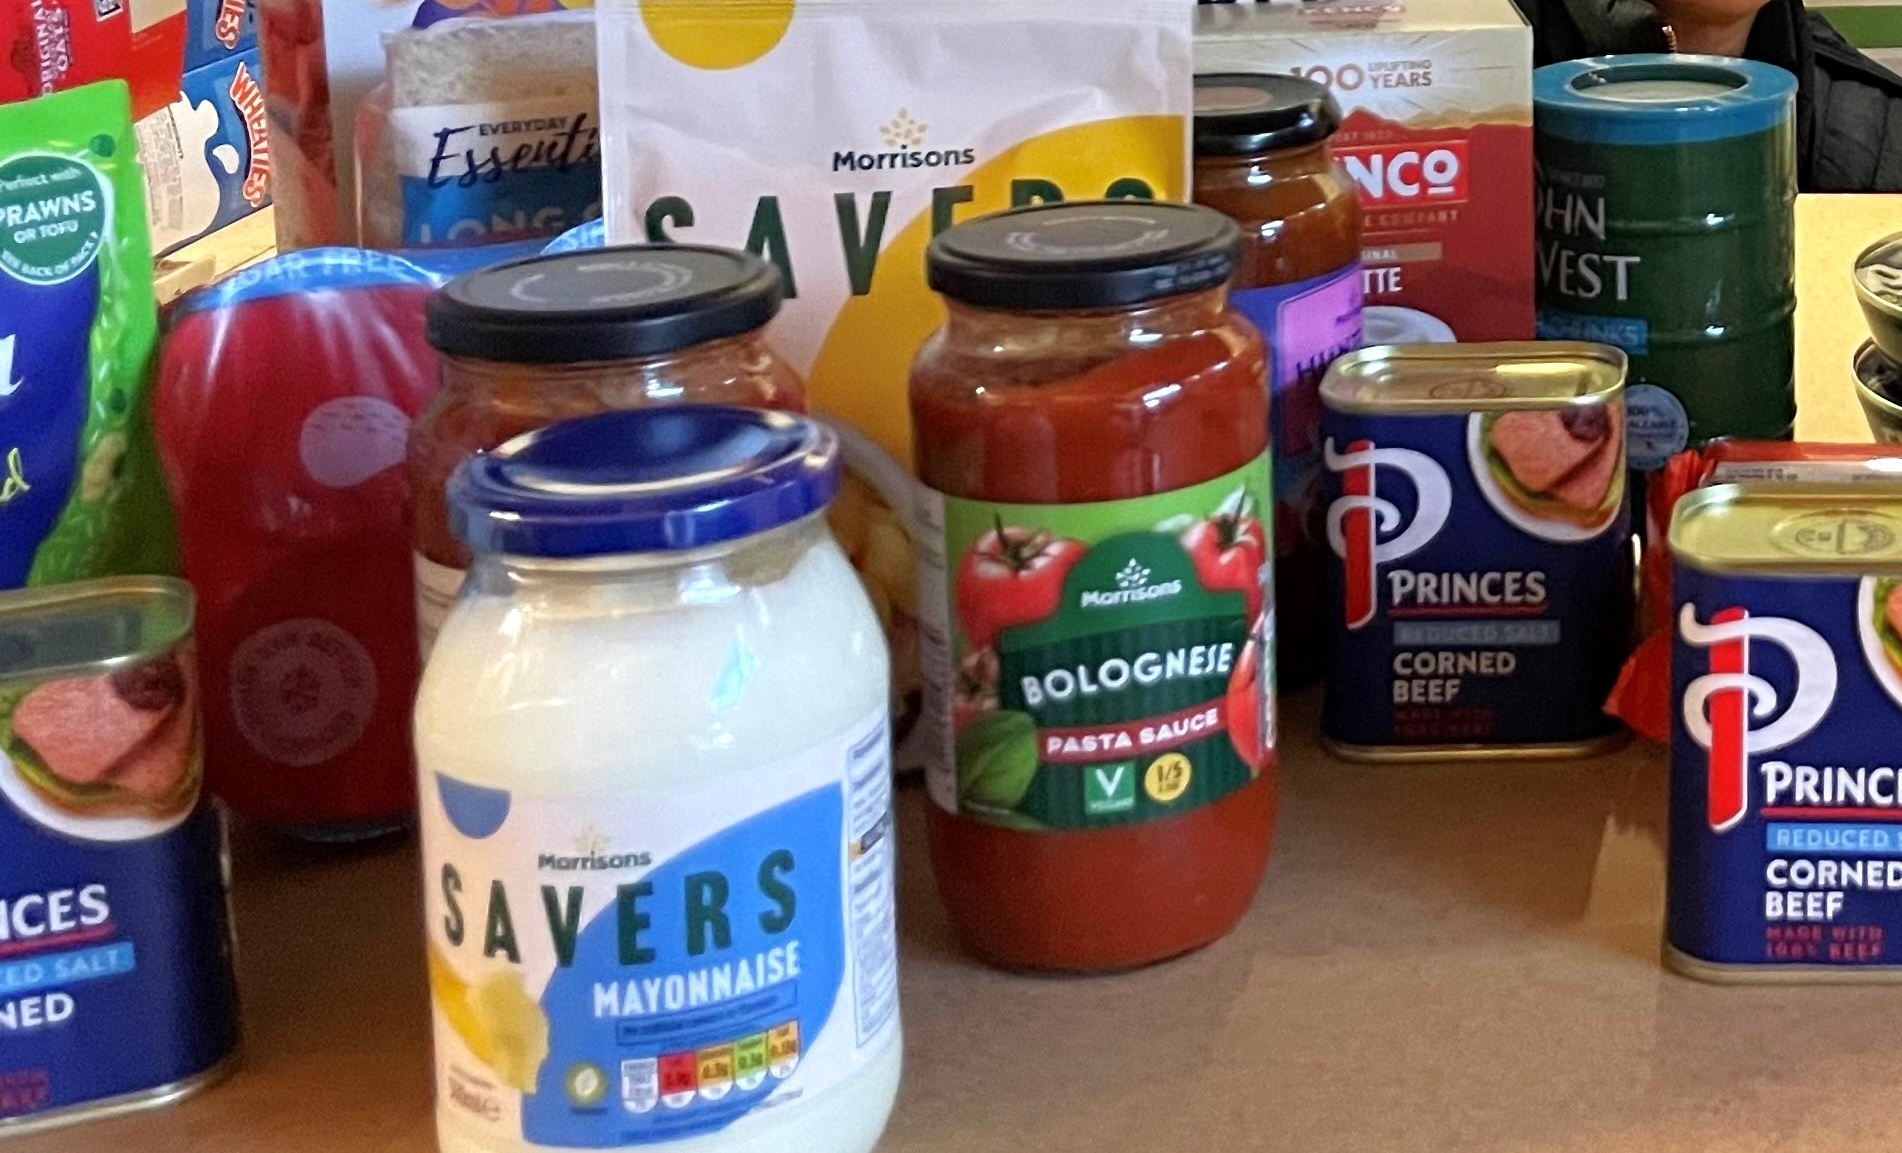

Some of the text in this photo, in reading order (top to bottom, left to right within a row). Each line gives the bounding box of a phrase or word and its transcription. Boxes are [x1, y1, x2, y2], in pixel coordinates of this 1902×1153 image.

[1370, 72, 1433, 89] YEARS
[229, 61, 273, 209] WHEATIES
[479, 116, 569, 137] EVERYDAY
[832, 144, 976, 173] Morrisons
[1079, 579, 1183, 608] Morrisons
[1387, 568, 1547, 607] PRINCES
[1020, 642, 1234, 706] BOLOGNESE
[1393, 651, 1517, 676] CORNED
[1393, 678, 1462, 704] BEEF
[1046, 708, 1219, 755] PASTA SAUCE
[1095, 766, 1125, 798] V
[1776, 828, 1889, 848] REDUCED
[537, 850, 652, 872] Morrisons
[441, 849, 797, 968] SAVERS
[1765, 891, 1845, 921] BEEF
[55, 949, 119, 979] SALT
[594, 940, 802, 1018] MAYONNAISE
